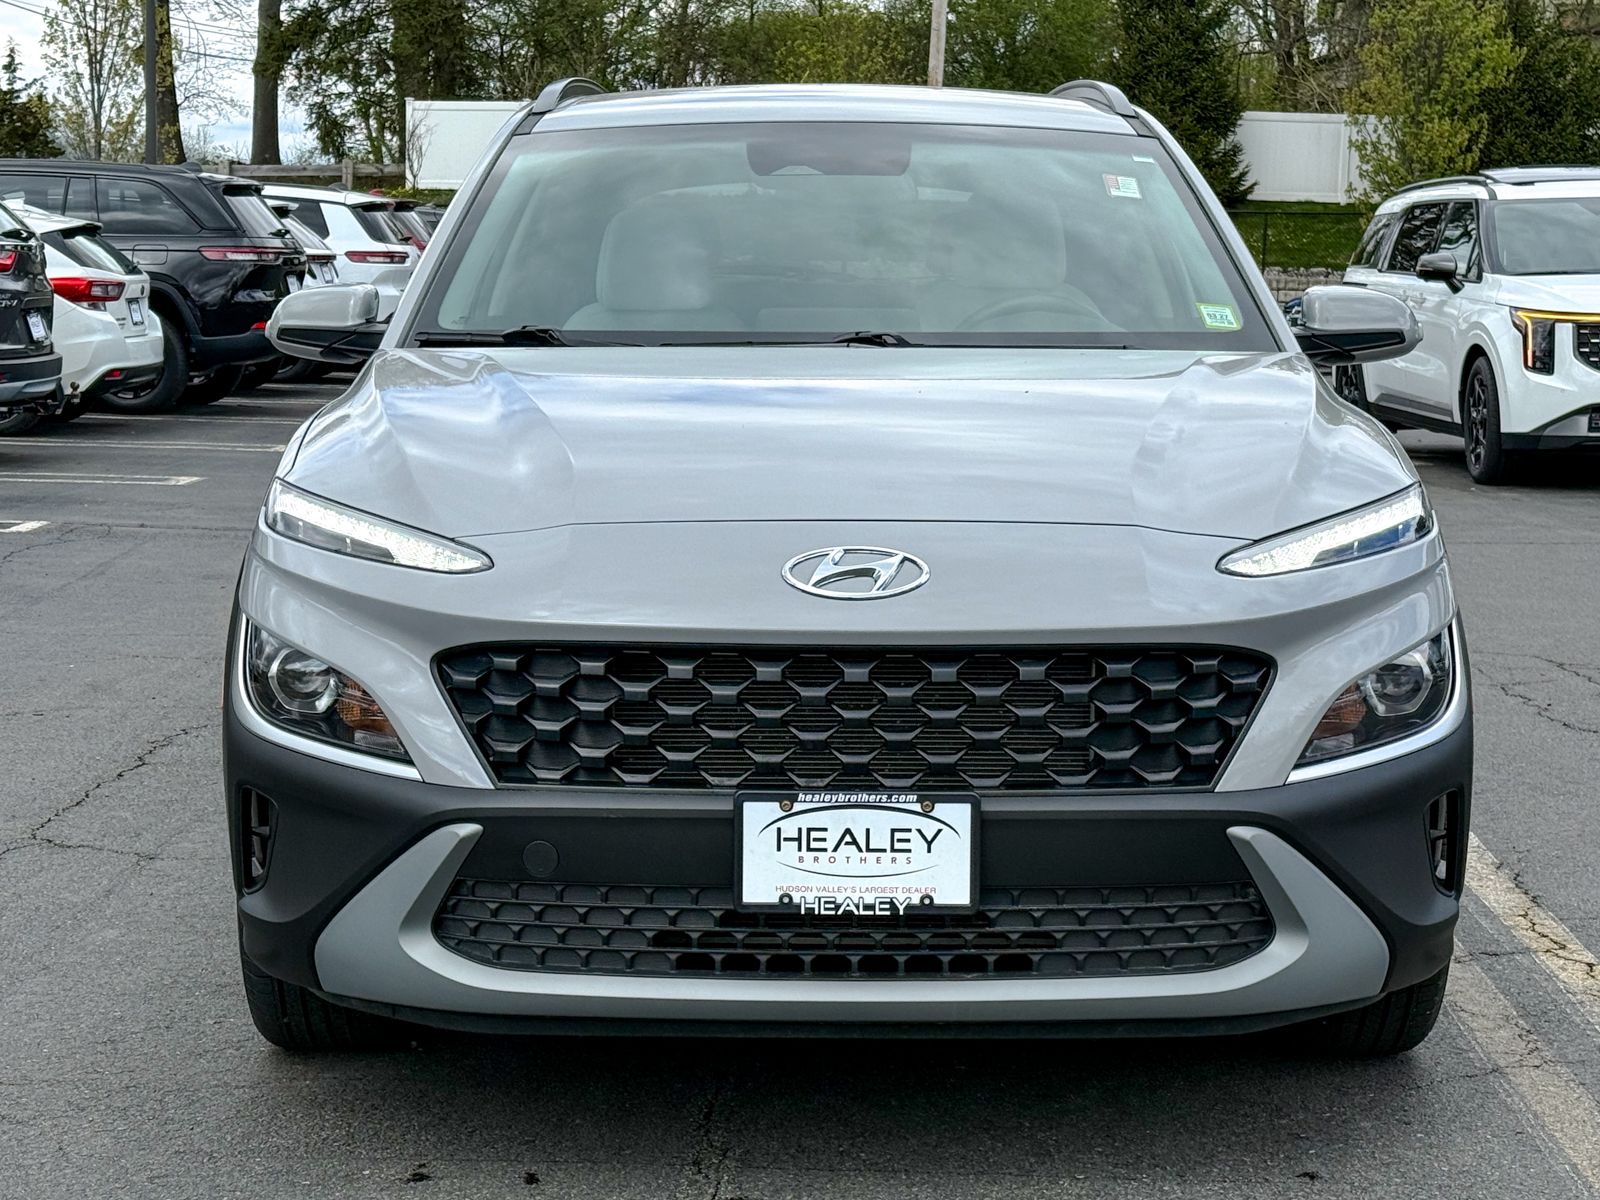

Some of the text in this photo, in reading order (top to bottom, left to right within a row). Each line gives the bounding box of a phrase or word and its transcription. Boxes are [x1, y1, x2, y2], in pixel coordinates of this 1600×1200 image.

[797, 793, 918, 804] healeybrothers.com
[776, 826, 943, 854] HEALEY
[798, 855, 912, 865] BROTHERS
[775, 885, 937, 895] HUDSON VALLEY'S LARGEST DEALER
[800, 896, 911, 915] HEALEY
